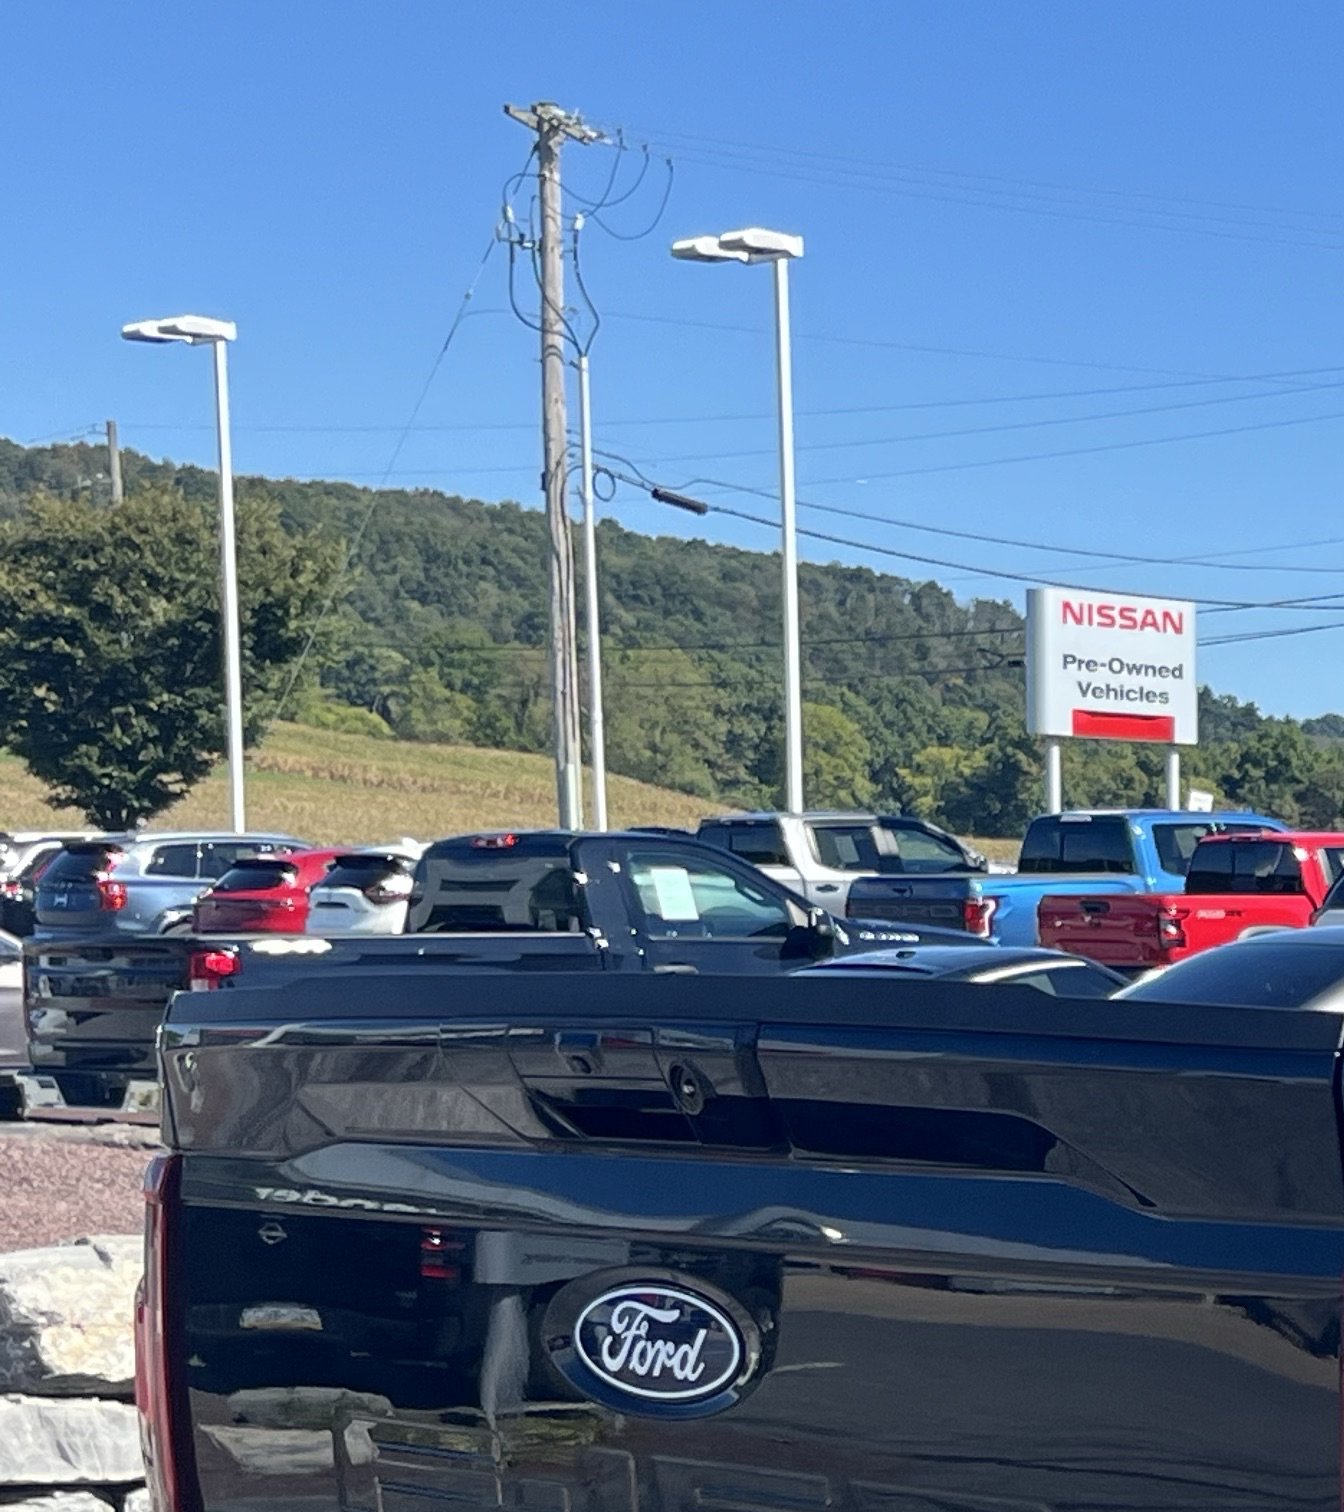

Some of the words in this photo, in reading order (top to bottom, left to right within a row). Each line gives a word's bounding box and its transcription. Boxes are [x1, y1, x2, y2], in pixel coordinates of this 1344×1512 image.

[1062, 600, 1183, 635] NISSAN
[1062, 653, 1183, 680] Pre-Owned
[1077, 680, 1169, 705] Vehicles
[602, 1300, 708, 1382] Ford
